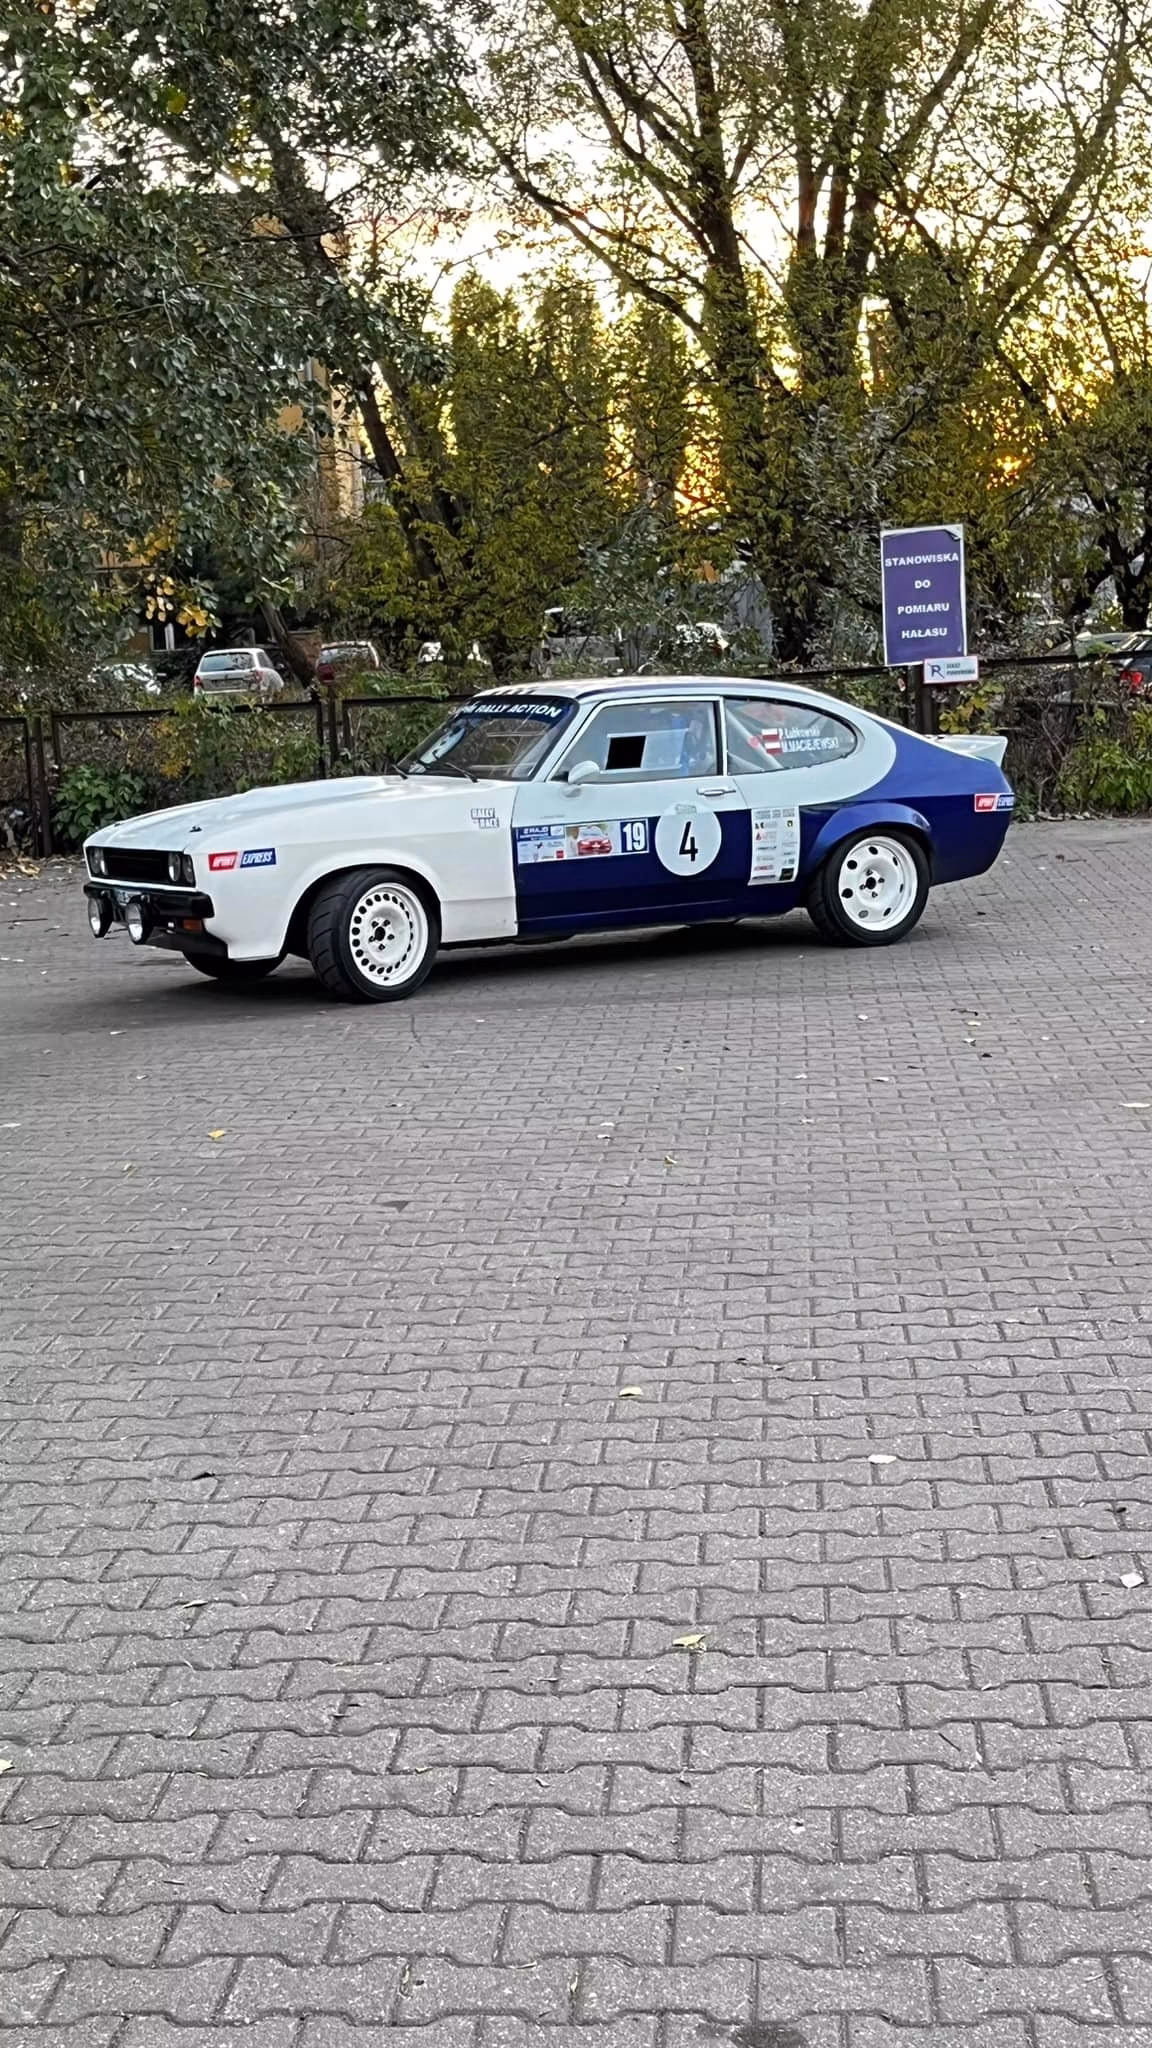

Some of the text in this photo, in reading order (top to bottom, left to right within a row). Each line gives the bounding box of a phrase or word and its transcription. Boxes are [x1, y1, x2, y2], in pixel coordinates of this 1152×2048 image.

[885, 552, 959, 567] STANOWISKA
[914, 579, 931, 589] DO
[897, 603, 950, 615] POMIARU
[901, 627, 948, 639] HAŁASU
[475, 704, 509, 713] RALLY
[507, 704, 562, 718] ACTION
[622, 822, 645, 851] 19
[679, 821, 699, 862] 4
[242, 851, 273, 865] EXPRESS
